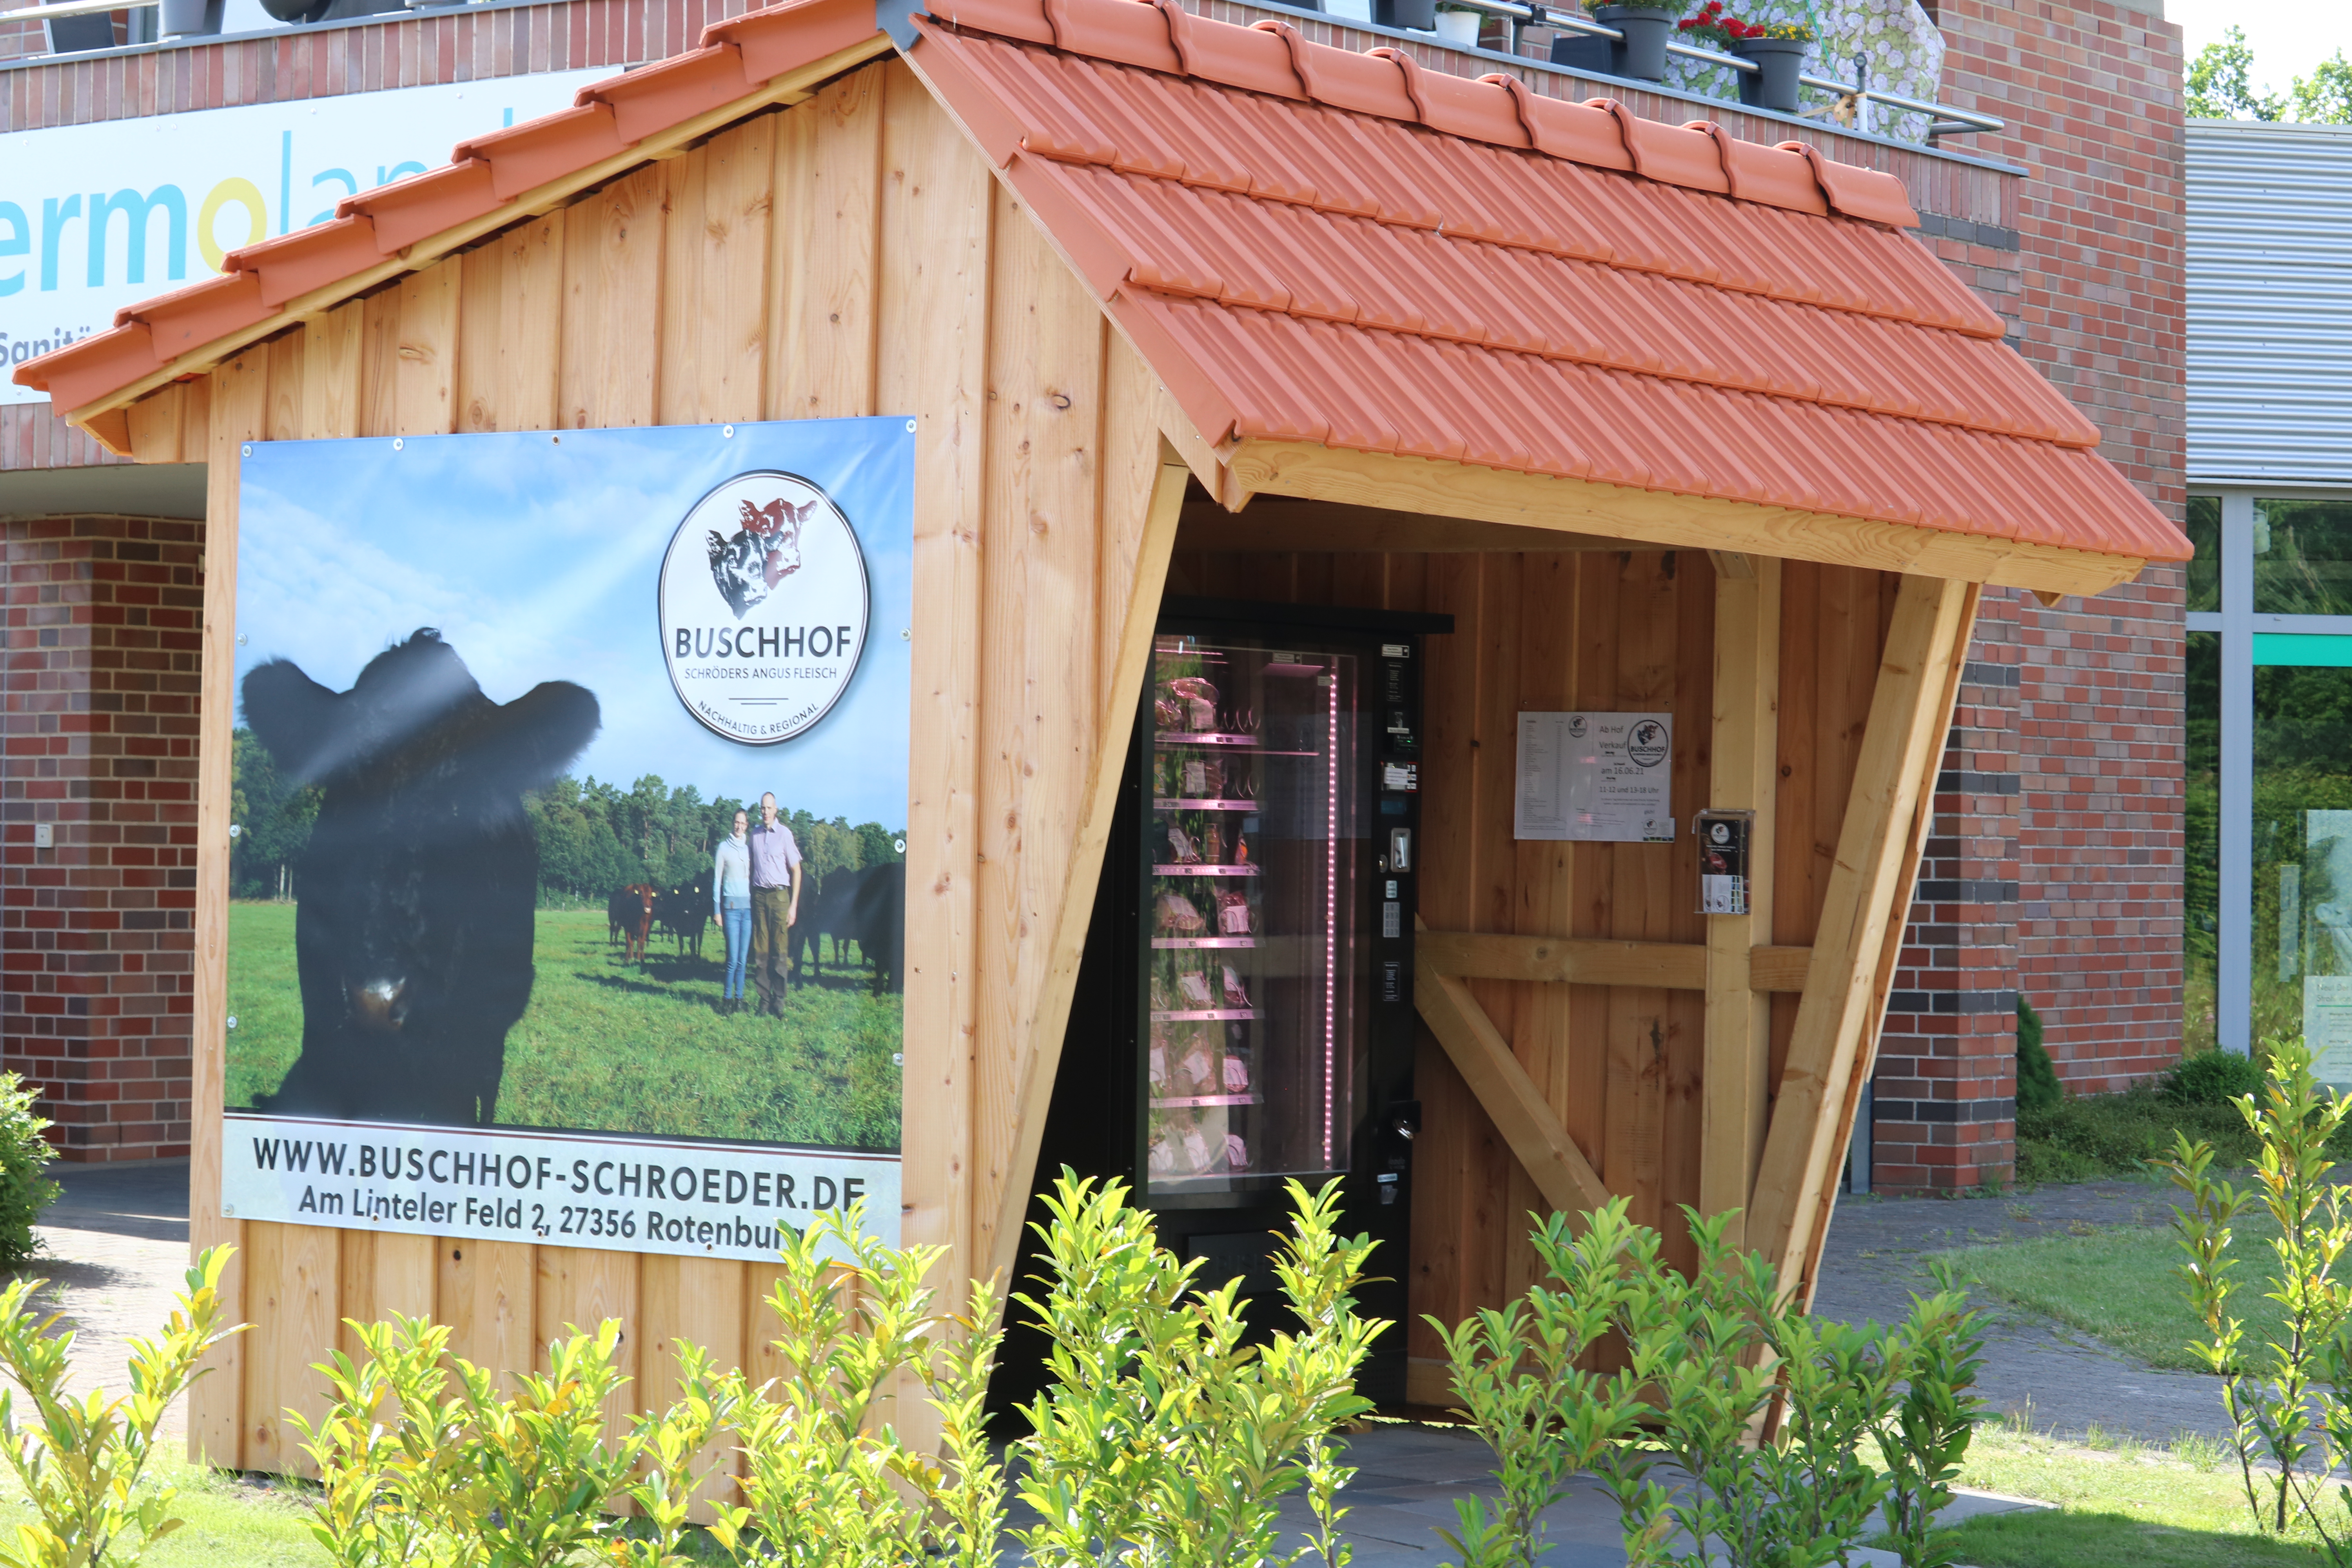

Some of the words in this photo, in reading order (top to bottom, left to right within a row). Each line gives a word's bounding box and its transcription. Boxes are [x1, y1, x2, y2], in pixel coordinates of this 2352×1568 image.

[676, 626, 851, 658] BUSCHHOF
[684, 666, 749, 679] SCHRÖDERS
[752, 668, 791, 679] ANGUS
[794, 667, 837, 679] FLEISCH
[698, 700, 757, 735] NACHHALTIG
[760, 726, 767, 735] &
[770, 703, 819, 734] REGIONAL
[253, 1137, 864, 1212] WWW.BUSCHHOF-SCHROEDER.DE
[298, 1185, 343, 1215] Am
[353, 1188, 457, 1223] Linteler
[466, 1197, 521, 1229] Feld
[531, 1204, 550, 1236] 2,
[560, 1205, 636, 1238] 27356
